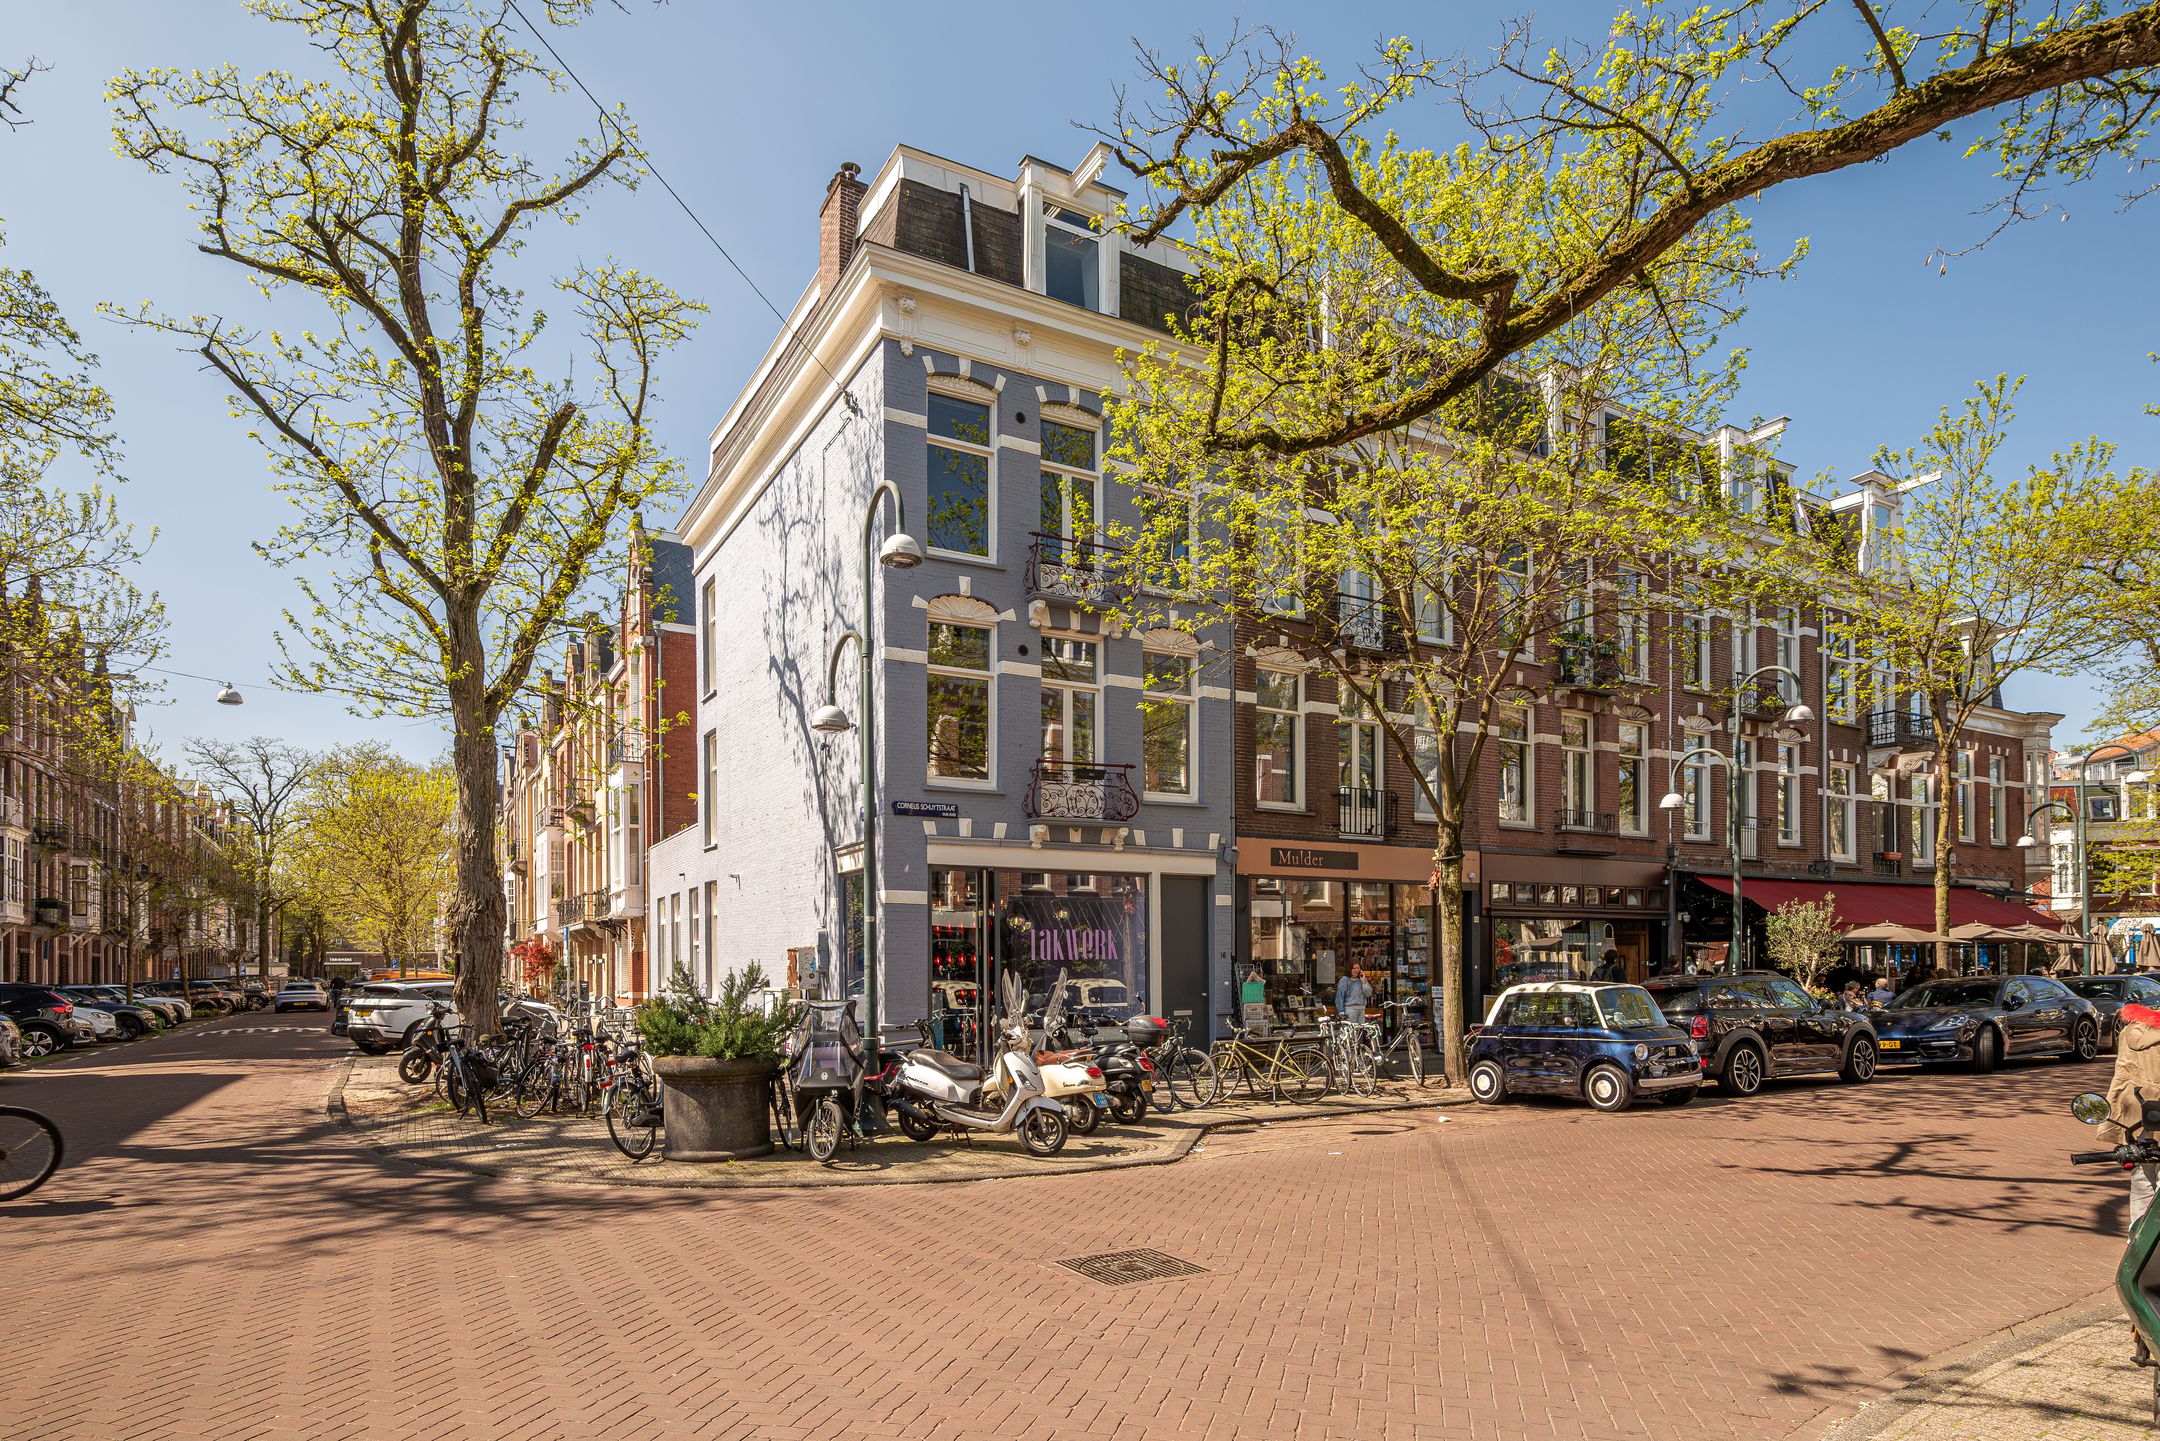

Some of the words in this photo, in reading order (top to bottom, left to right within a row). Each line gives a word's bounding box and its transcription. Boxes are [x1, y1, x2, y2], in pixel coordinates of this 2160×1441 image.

[897, 802, 919, 810] CORNELIS
[920, 803, 956, 811] SCHUYTSTRAAT
[1278, 850, 1324, 866] Mulder
